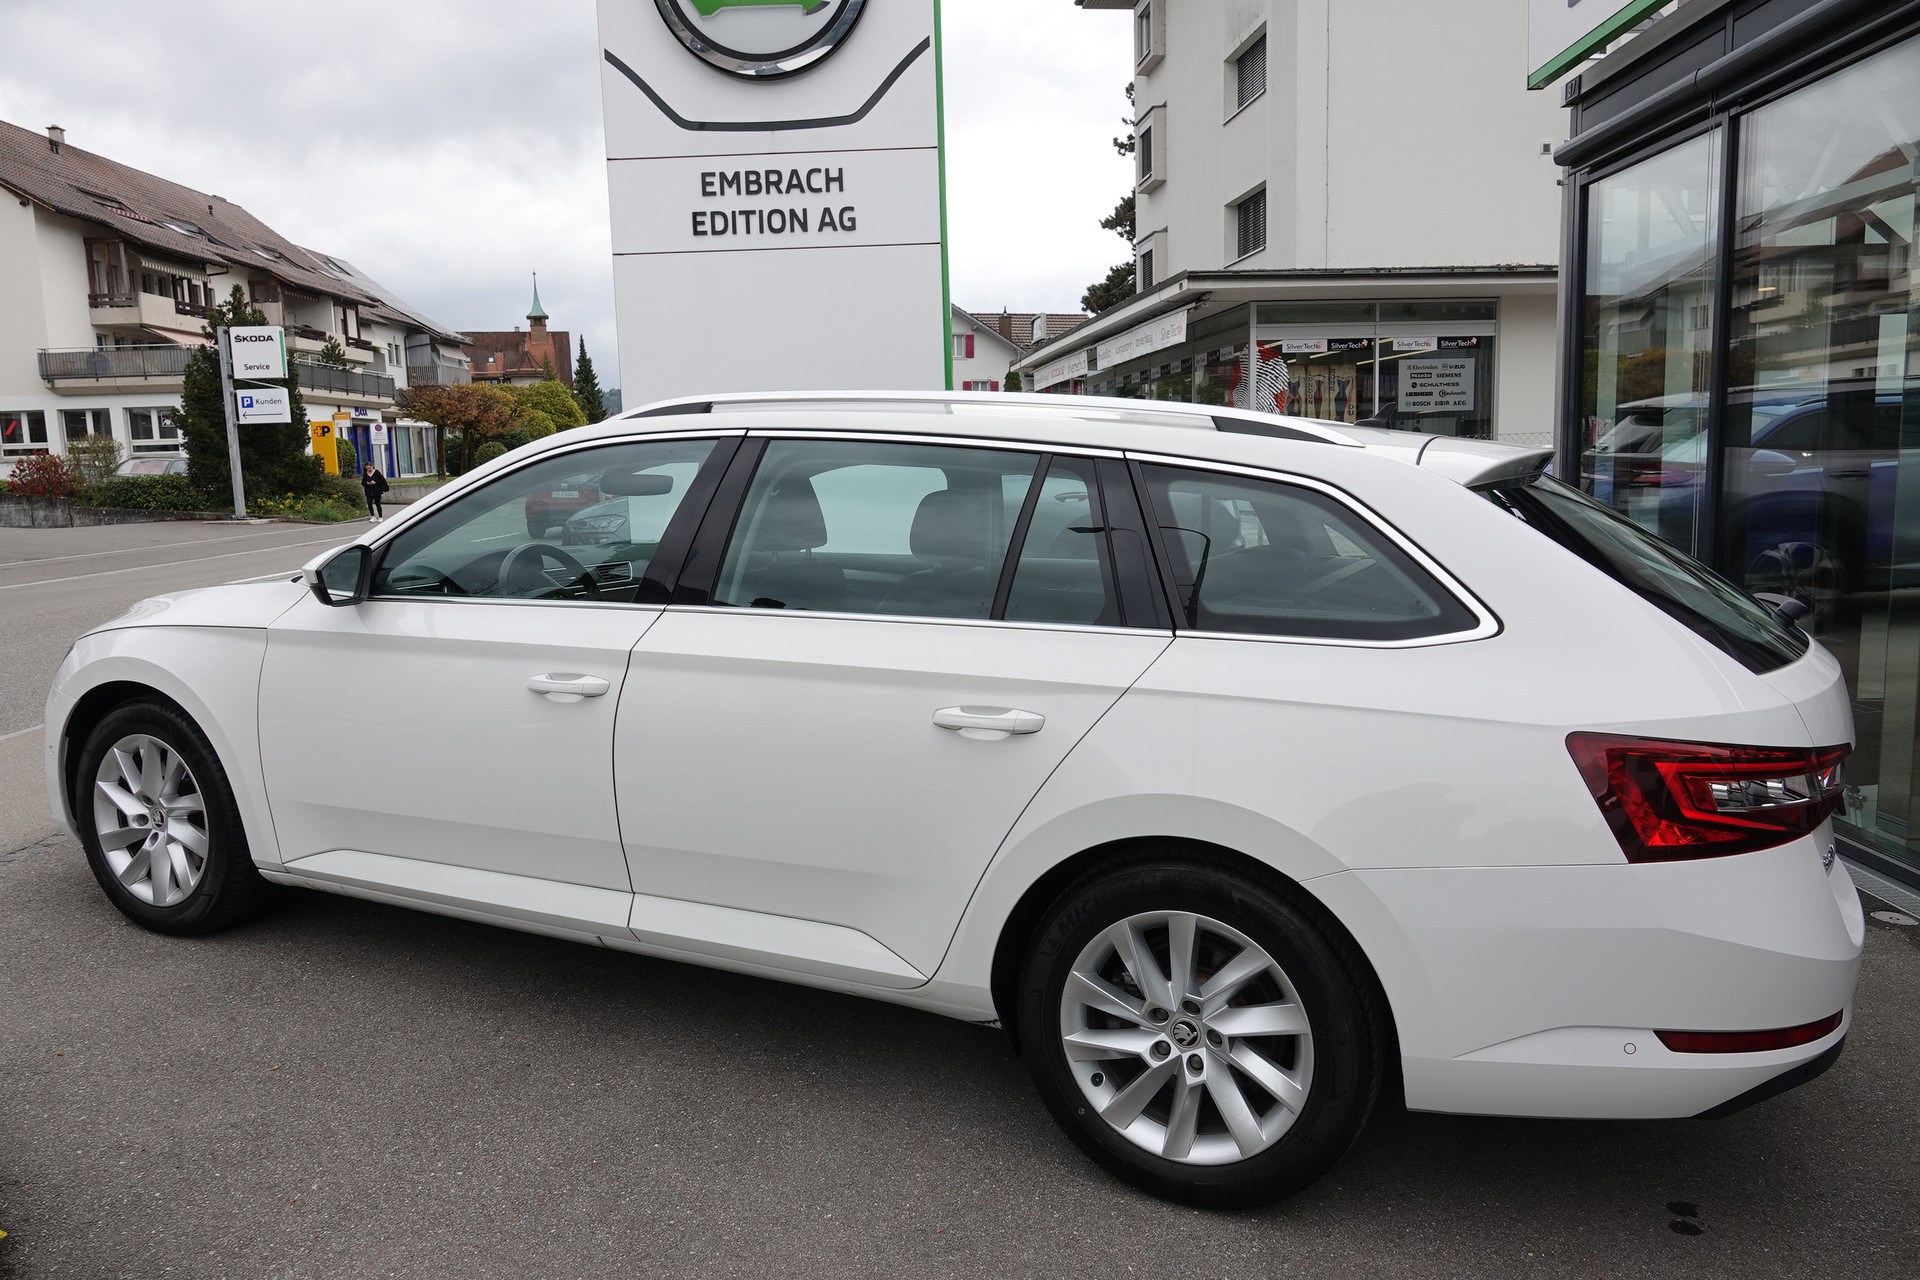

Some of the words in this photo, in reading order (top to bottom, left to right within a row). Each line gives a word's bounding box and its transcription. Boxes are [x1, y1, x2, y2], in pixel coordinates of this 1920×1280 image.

[701, 167, 844, 197] EMBRACH
[692, 207, 808, 236] EDITION
[817, 206, 857, 232] AG
[234, 334, 274, 343] ŠKODA
[1441, 339, 1474, 347] SilverTech
[243, 363, 270, 371] Service
